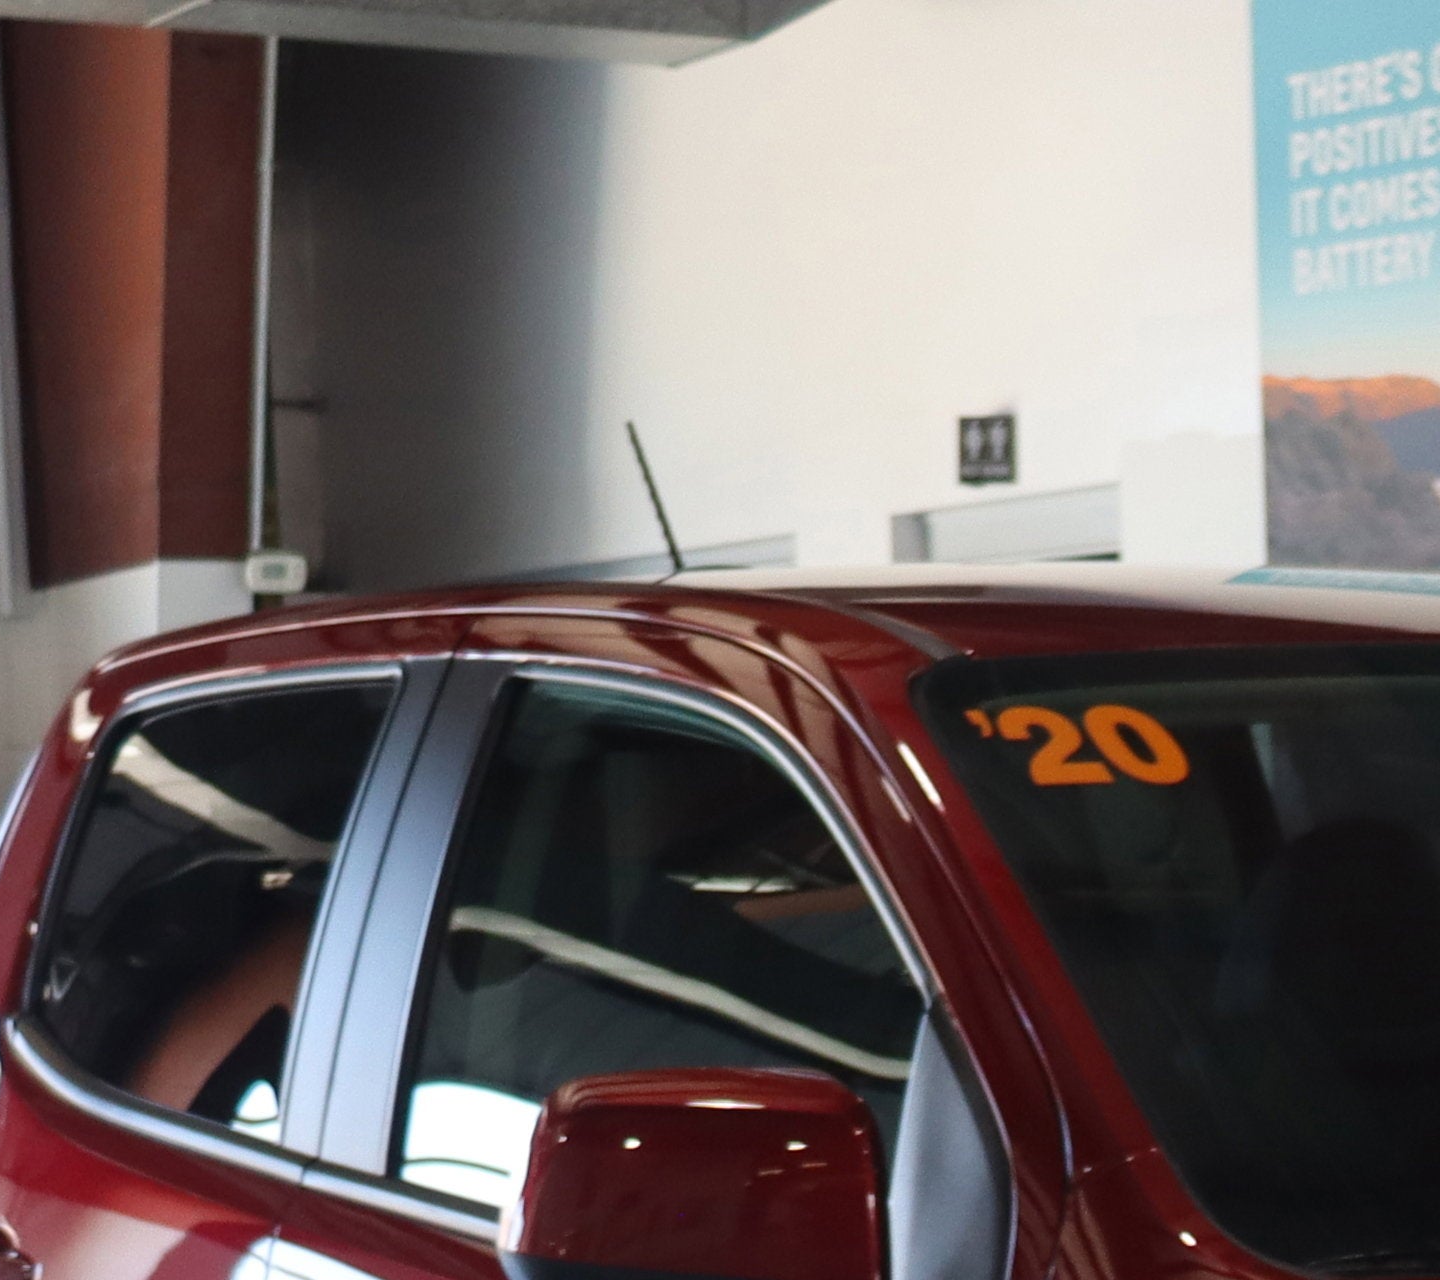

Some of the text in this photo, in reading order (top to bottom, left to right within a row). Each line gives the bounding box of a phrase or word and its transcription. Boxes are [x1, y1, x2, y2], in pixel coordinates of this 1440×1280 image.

[1285, 48, 1424, 121] THERE'S
[1288, 187, 1323, 238] IT
[1291, 228, 1436, 296] BATTERY
